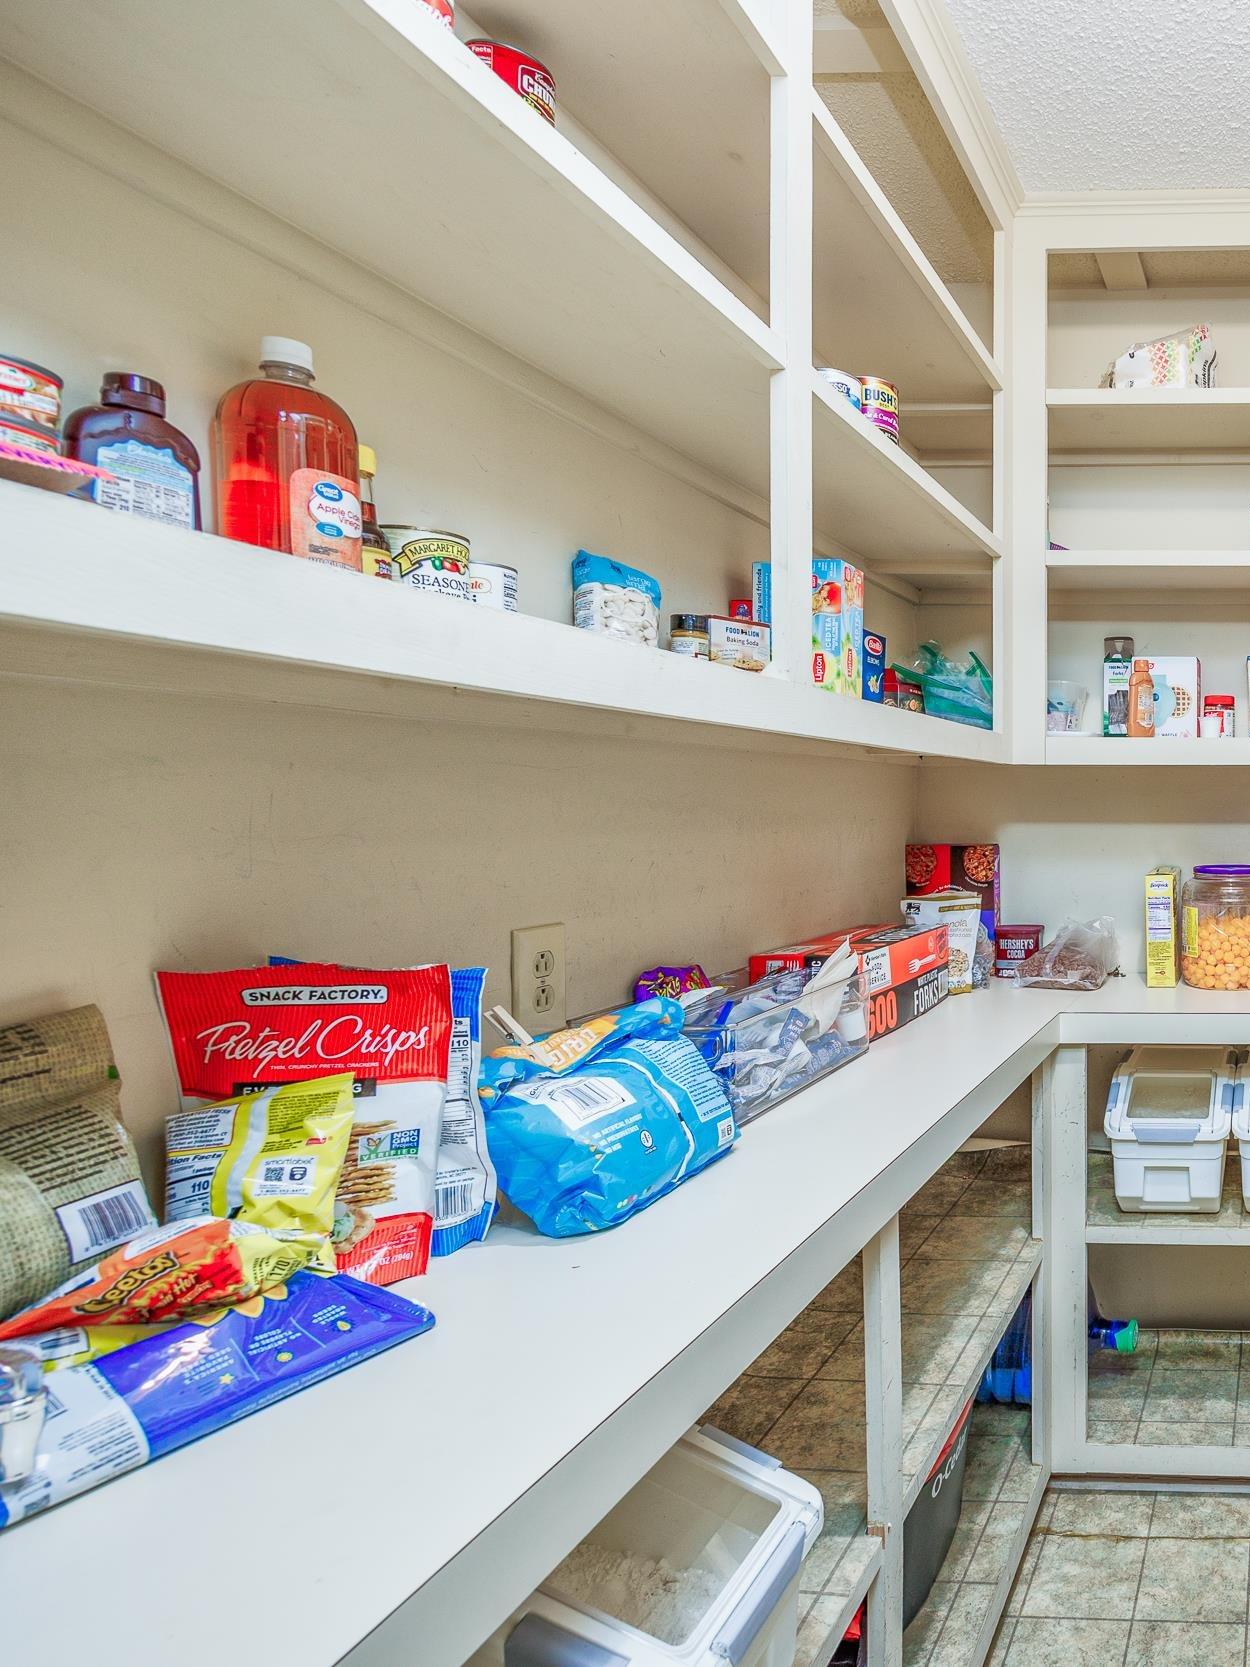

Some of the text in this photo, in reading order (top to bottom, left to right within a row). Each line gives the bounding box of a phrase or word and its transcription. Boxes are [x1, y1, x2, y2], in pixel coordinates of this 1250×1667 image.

[317, 503, 345, 516] Apple
[408, 543, 455, 557] MARGARET
[725, 626, 760, 638] FOOD LION
[726, 636, 759, 647] Baking Soda
[814, 654, 824, 681] Lipton
[998, 937, 1035, 950] HERSHEY'S
[1006, 949, 1026, 959] COCOA
[249, 988, 381, 1002] SNACK FACTORY
[913, 982, 939, 1016] FORKS
[196, 1015, 430, 1079] Pretzel Crisps
[393, 1129, 418, 1139] NON
[393, 1135, 418, 1144] GMO
[192, 1152, 223, 1162] Facts
[361, 1149, 417, 1161] VERIFIED
[264, 1158, 312, 1167] smartlabel
[192, 1180, 210, 1194] 110
[379, 1256, 390, 1265] OZ
[273, 1257, 291, 1280] 170
